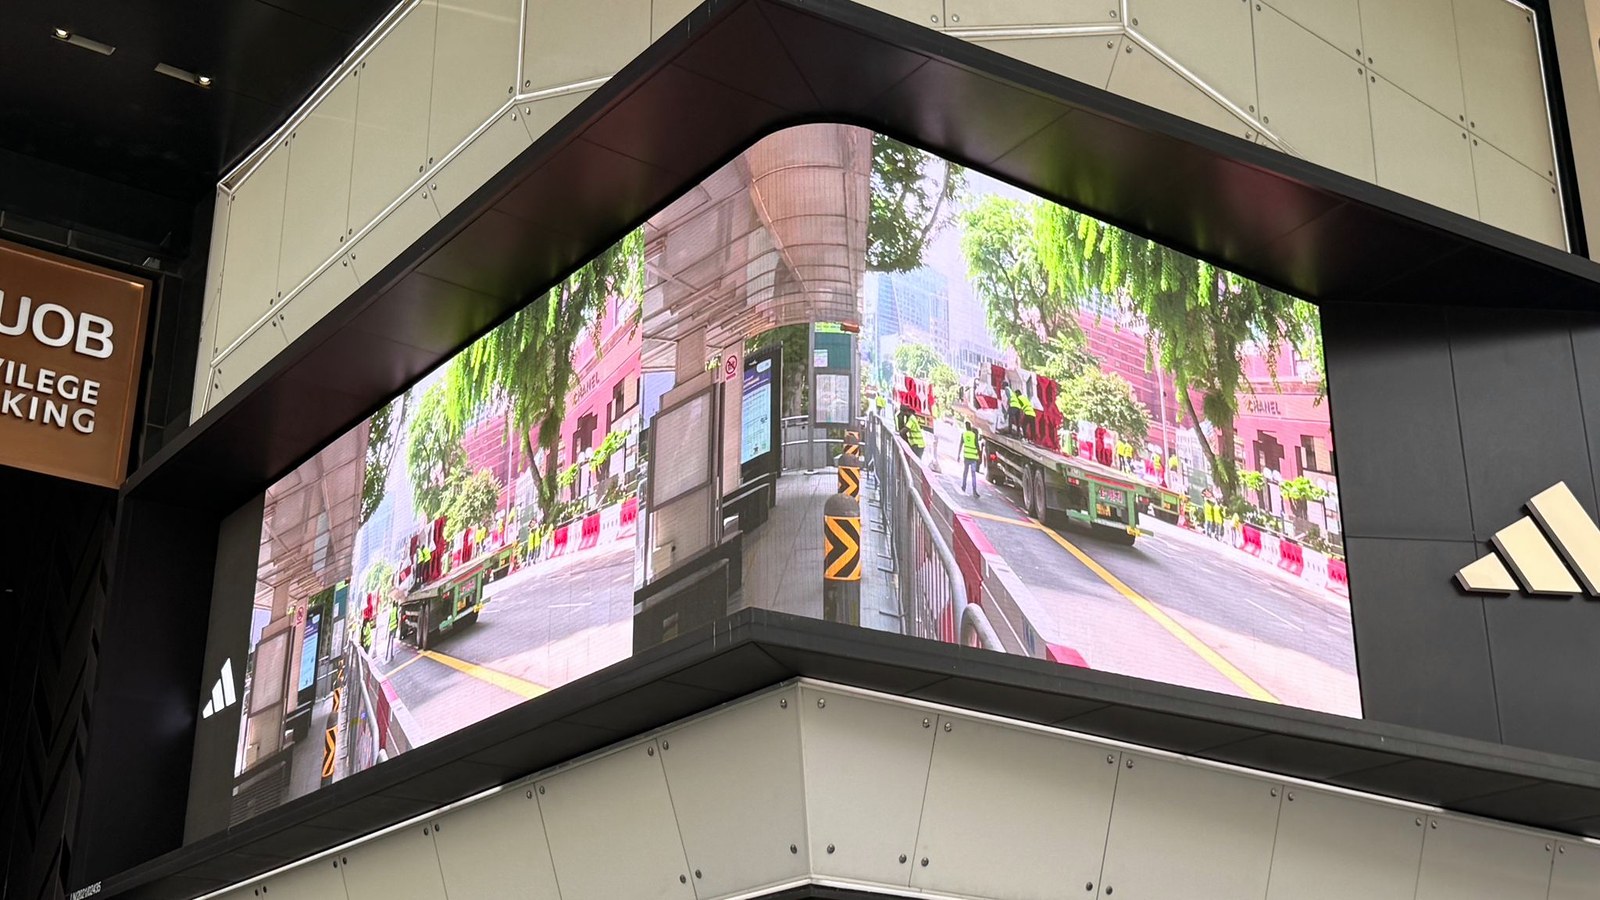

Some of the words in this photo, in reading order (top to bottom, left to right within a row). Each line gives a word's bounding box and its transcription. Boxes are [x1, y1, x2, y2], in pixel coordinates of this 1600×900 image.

[0, 290, 114, 359] UOB
[1, 389, 95, 434] KING
[1246, 399, 1281, 415] CHANEL
